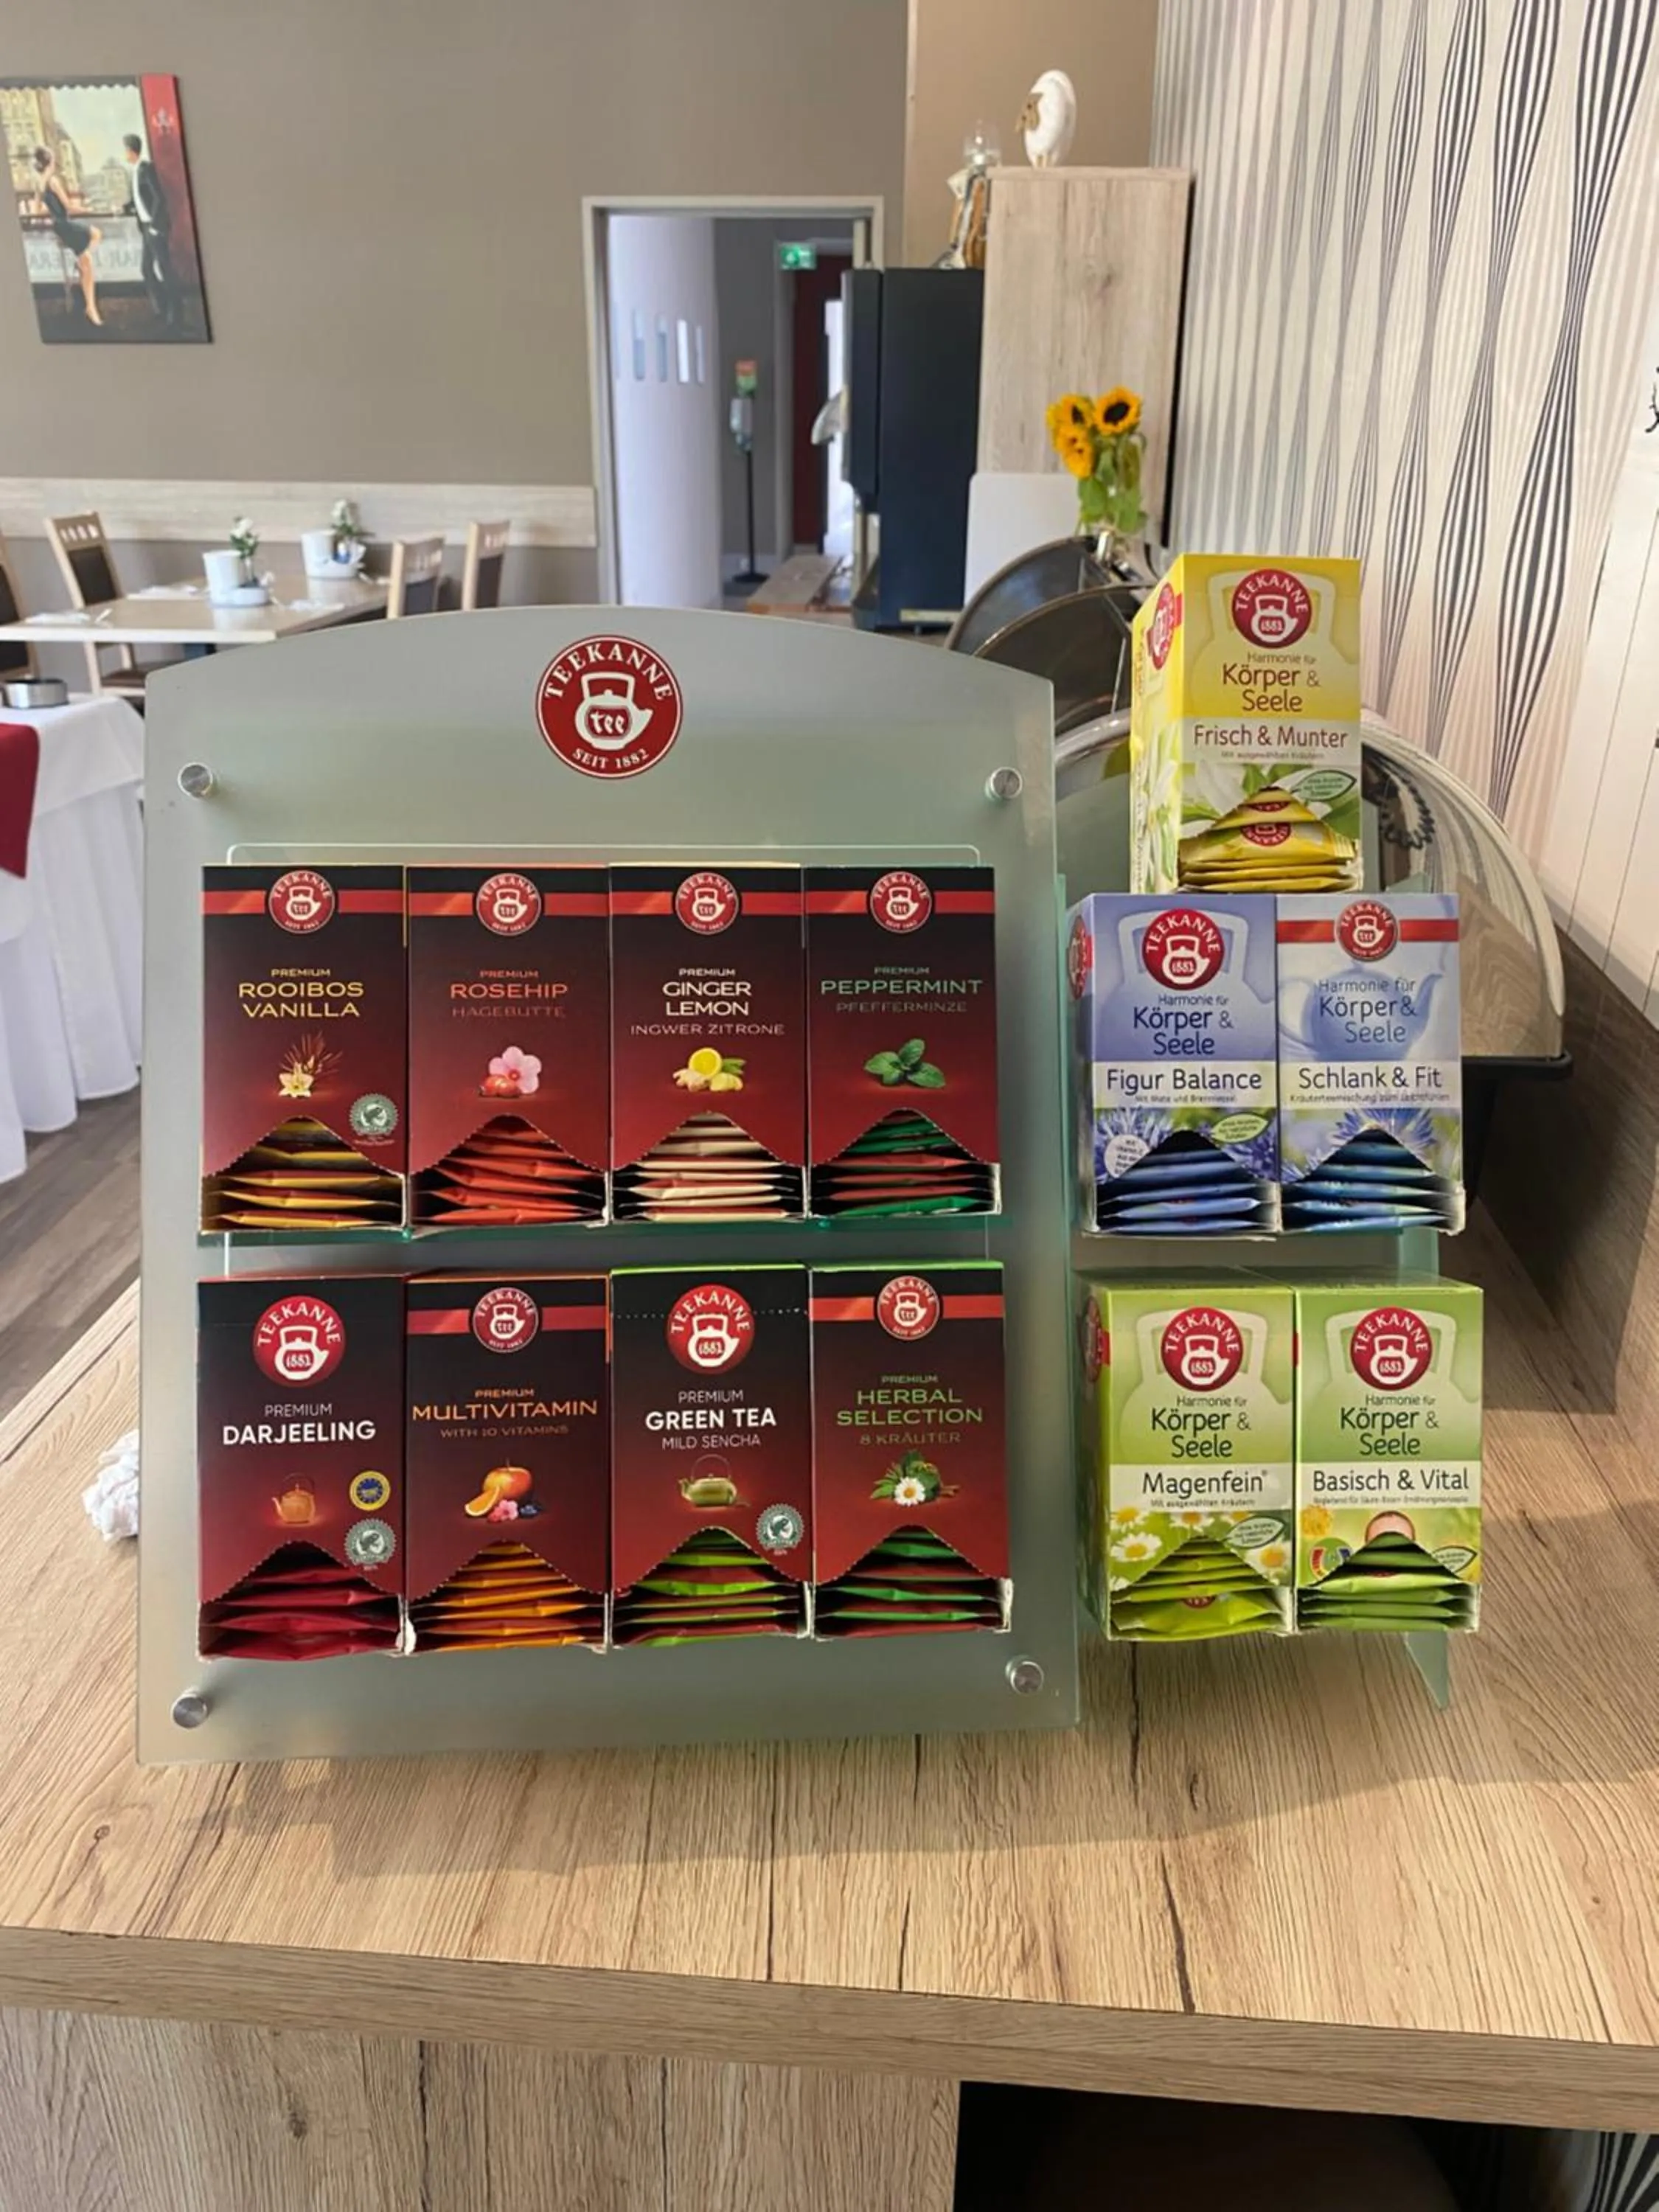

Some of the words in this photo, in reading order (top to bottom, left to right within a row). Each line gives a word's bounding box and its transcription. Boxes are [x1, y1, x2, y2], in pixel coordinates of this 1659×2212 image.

[1235, 574, 1308, 613] TEEKANNE
[1247, 652, 1301, 664] Harmonie
[544, 643, 673, 700] TEEKANNE
[1222, 663, 1301, 692] Körper
[1307, 669, 1321, 687] &
[1242, 689, 1303, 712] Seele
[591, 711, 625, 734] tee
[1194, 723, 1252, 745] Frisch
[1257, 726, 1272, 746] &
[1277, 726, 1349, 748] Munter
[572, 748, 608, 769] SEIT
[615, 748, 650, 769] 1882
[273, 873, 330, 899] TEEKANNE
[480, 876, 536, 901] TEEKANNE
[679, 876, 734, 900] TEEKANNE
[874, 874, 928, 899] TEEKANNE
[1341, 904, 1393, 928] TEEKANNE
[1146, 914, 1221, 954] TEEKANNE
[271, 968, 330, 977] PREMIUM
[479, 970, 539, 978] PREMIUM
[678, 968, 735, 977] PREMIUM
[874, 967, 930, 975] PREMIUM
[238, 982, 364, 998] ROOIBOS
[451, 984, 568, 999] ROSEHIP
[663, 981, 751, 997] GINGER
[820, 980, 983, 995] PEPPERMINT
[1318, 979, 1389, 992] Harmonie
[1395, 979, 1416, 992] für
[243, 1003, 360, 1018] VANILLA
[666, 1001, 748, 1016] LEMON
[835, 1001, 967, 1013] PFEFFERMINZE
[1158, 994, 1214, 1006] Harmonie
[1319, 996, 1399, 1023] Körper
[1400, 995, 1417, 1017] &
[452, 1006, 566, 1018] HAGEBUTTE
[1133, 1006, 1213, 1034] Körper
[1218, 1010, 1234, 1029] &
[630, 1024, 702, 1035] INGWER
[707, 1023, 785, 1035] ZITRONE
[1344, 1020, 1406, 1043] Seele
[1153, 1031, 1215, 1055] Seele
[1107, 1068, 1164, 1096] Figur
[1172, 1067, 1262, 1090] Balance
[1298, 1066, 1388, 1089] Schlank
[1391, 1066, 1409, 1088] &
[1415, 1066, 1442, 1088] Fit
[880, 1279, 935, 1304] TEEKANNE
[477, 1290, 534, 1317] TEEKANNE
[671, 1290, 750, 1334] TEEKANNE
[257, 1301, 341, 1347] TEEKANNE
[1165, 1312, 1239, 1354] TEEKANNE
[1354, 1312, 1428, 1354] TEEKANNE
[881, 1375, 939, 1383] PREMIUM
[474, 1388, 535, 1399] PREMIUM
[678, 1390, 744, 1403] PREMIUM
[857, 1388, 962, 1405] HERBAL
[1176, 1395, 1232, 1407] Harmonie
[1366, 1394, 1420, 1406] Harmonie
[265, 1403, 333, 1417] PREMIUM
[412, 1400, 598, 1421] MULTIVITAMIN
[645, 1410, 724, 1431] GREEN
[731, 1408, 776, 1427] TEA
[836, 1408, 983, 1426] SELECTION
[1340, 1407, 1420, 1436] Körper
[1425, 1411, 1439, 1429] &
[223, 1420, 376, 1445] DARJEELING
[440, 1427, 478, 1439] WITH
[481, 1427, 498, 1438] 10
[501, 1425, 568, 1437] VITAMINS
[1151, 1408, 1231, 1438] Körper
[1237, 1411, 1251, 1431] &
[662, 1436, 698, 1450] MILD
[702, 1434, 761, 1448] SENCHA
[860, 1435, 870, 1446] 8
[877, 1431, 961, 1444] KRÄUTER
[1171, 1433, 1233, 1458] Seele
[1359, 1432, 1421, 1455] Seele
[1313, 1468, 1389, 1491] Basisch
[1397, 1469, 1415, 1490] &
[1420, 1467, 1470, 1490] Vital
